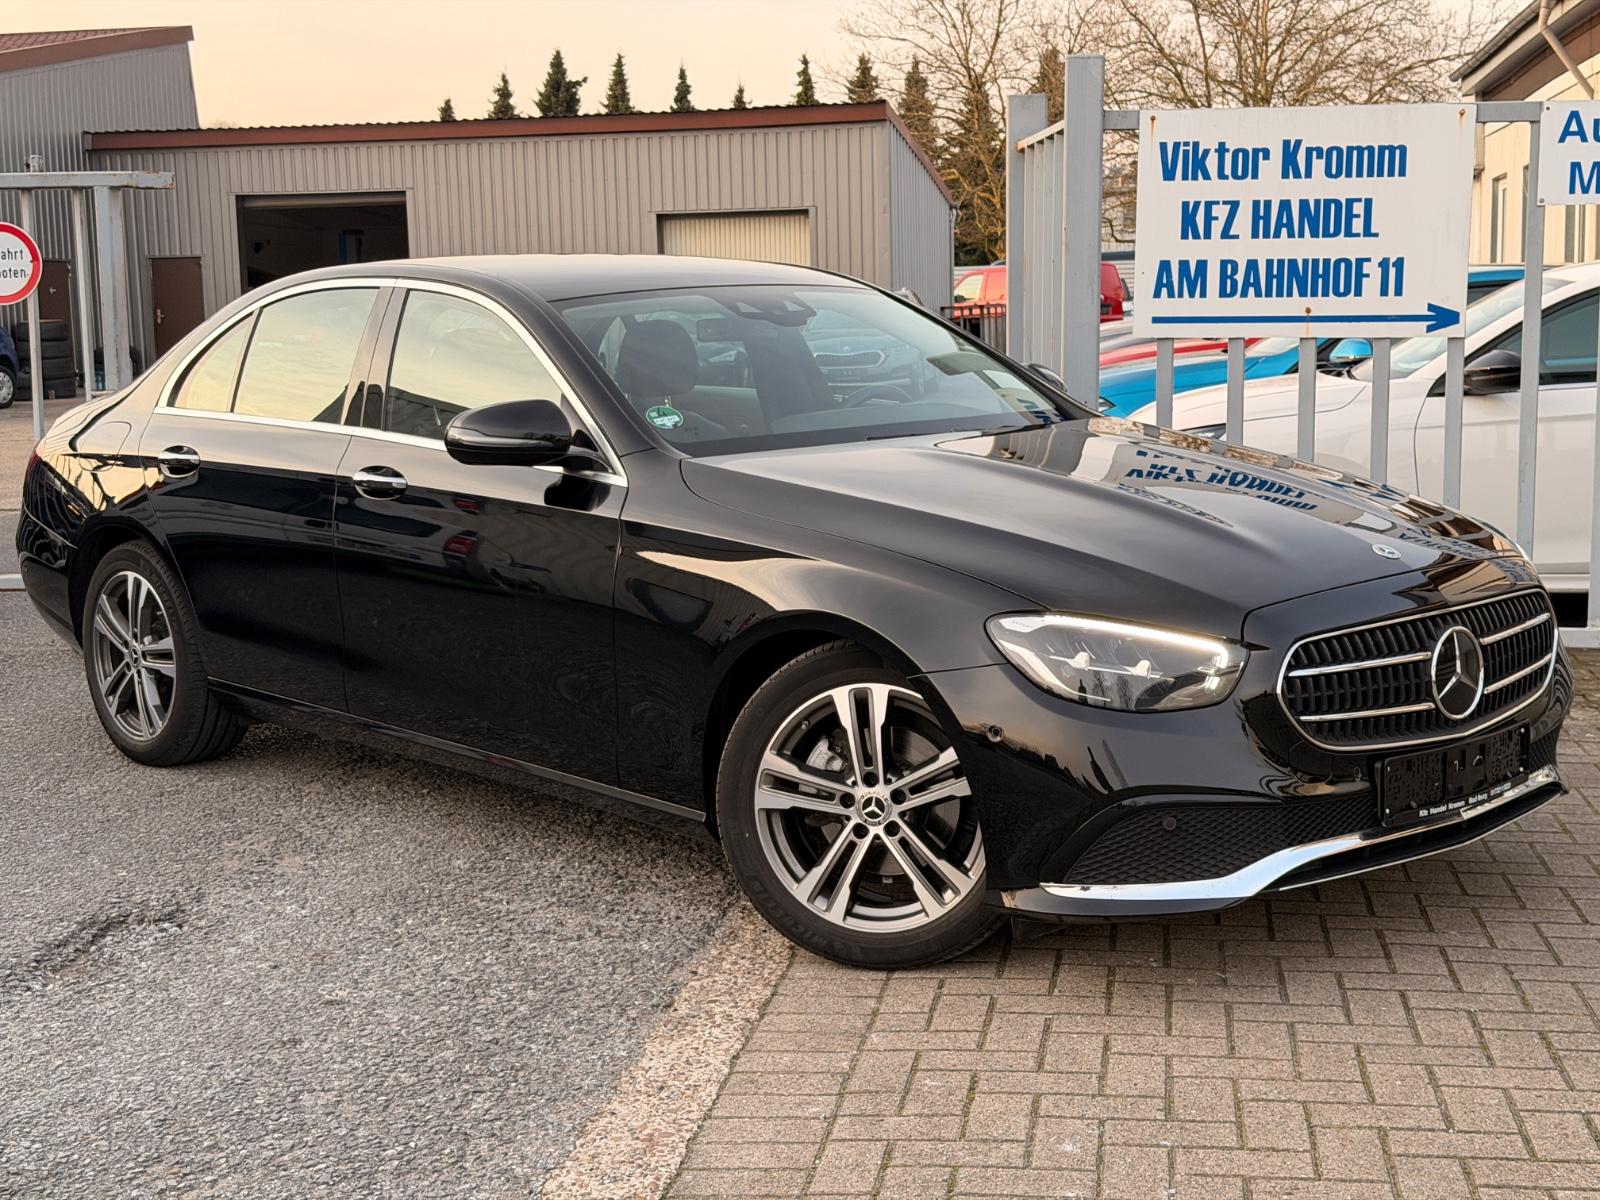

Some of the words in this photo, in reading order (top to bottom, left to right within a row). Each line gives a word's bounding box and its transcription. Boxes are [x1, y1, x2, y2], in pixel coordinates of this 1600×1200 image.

[1160, 141, 1271, 182] Viktor
[1281, 139, 1408, 180] Kromm
[1180, 199, 1240, 241] KFZ
[1251, 197, 1379, 240] HANDEL
[0, 267, 26, 278] oten
[1153, 259, 1208, 299] AM
[1218, 257, 1371, 298] BAHNHOF
[1379, 256, 1406, 298] 11
[1430, 804, 1447, 814] Handel
[1448, 801, 1465, 809] Kromm
